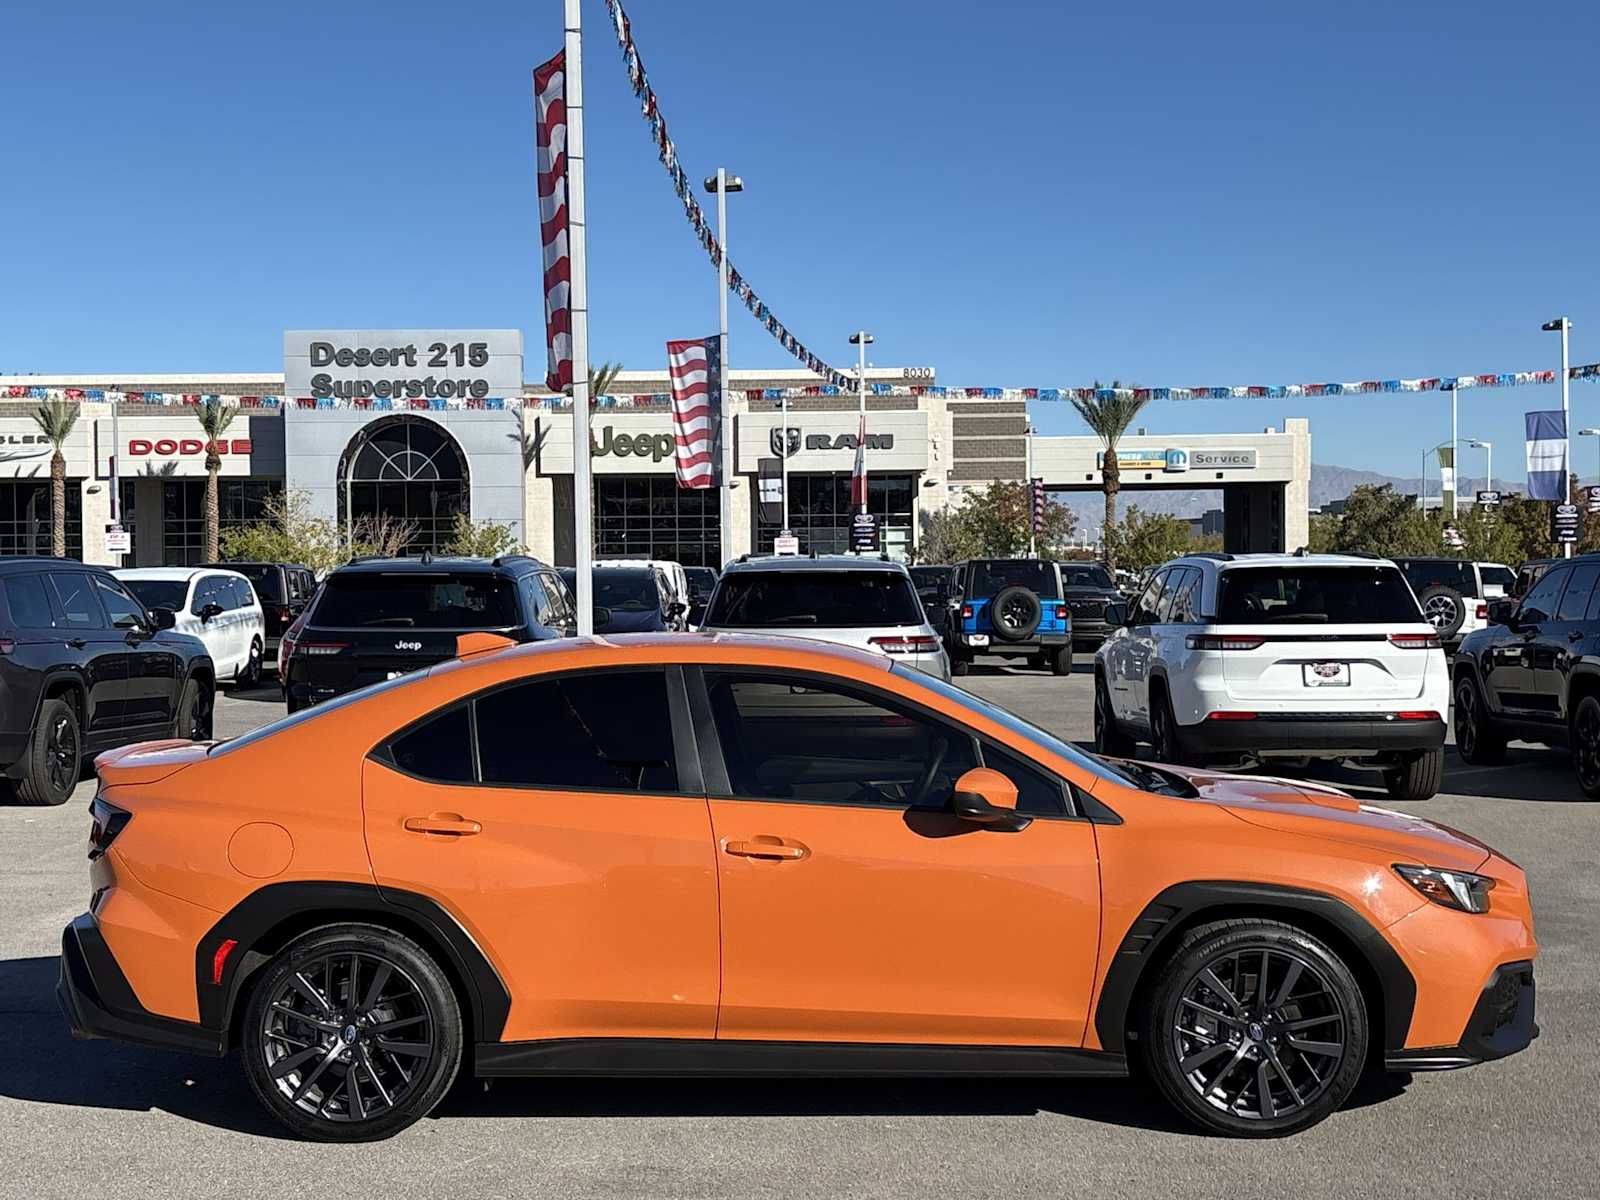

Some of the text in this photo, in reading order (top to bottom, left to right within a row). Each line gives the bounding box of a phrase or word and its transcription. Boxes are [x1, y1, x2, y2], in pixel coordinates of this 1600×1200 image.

[310, 342, 489, 367] Desert 215
[903, 367, 931, 378] 8030
[310, 373, 489, 400] Superstore
[591, 426, 675, 463] Jeep
[805, 433, 894, 450] RAM
[1195, 453, 1250, 465] Service
[394, 639, 422, 651] Jeep
